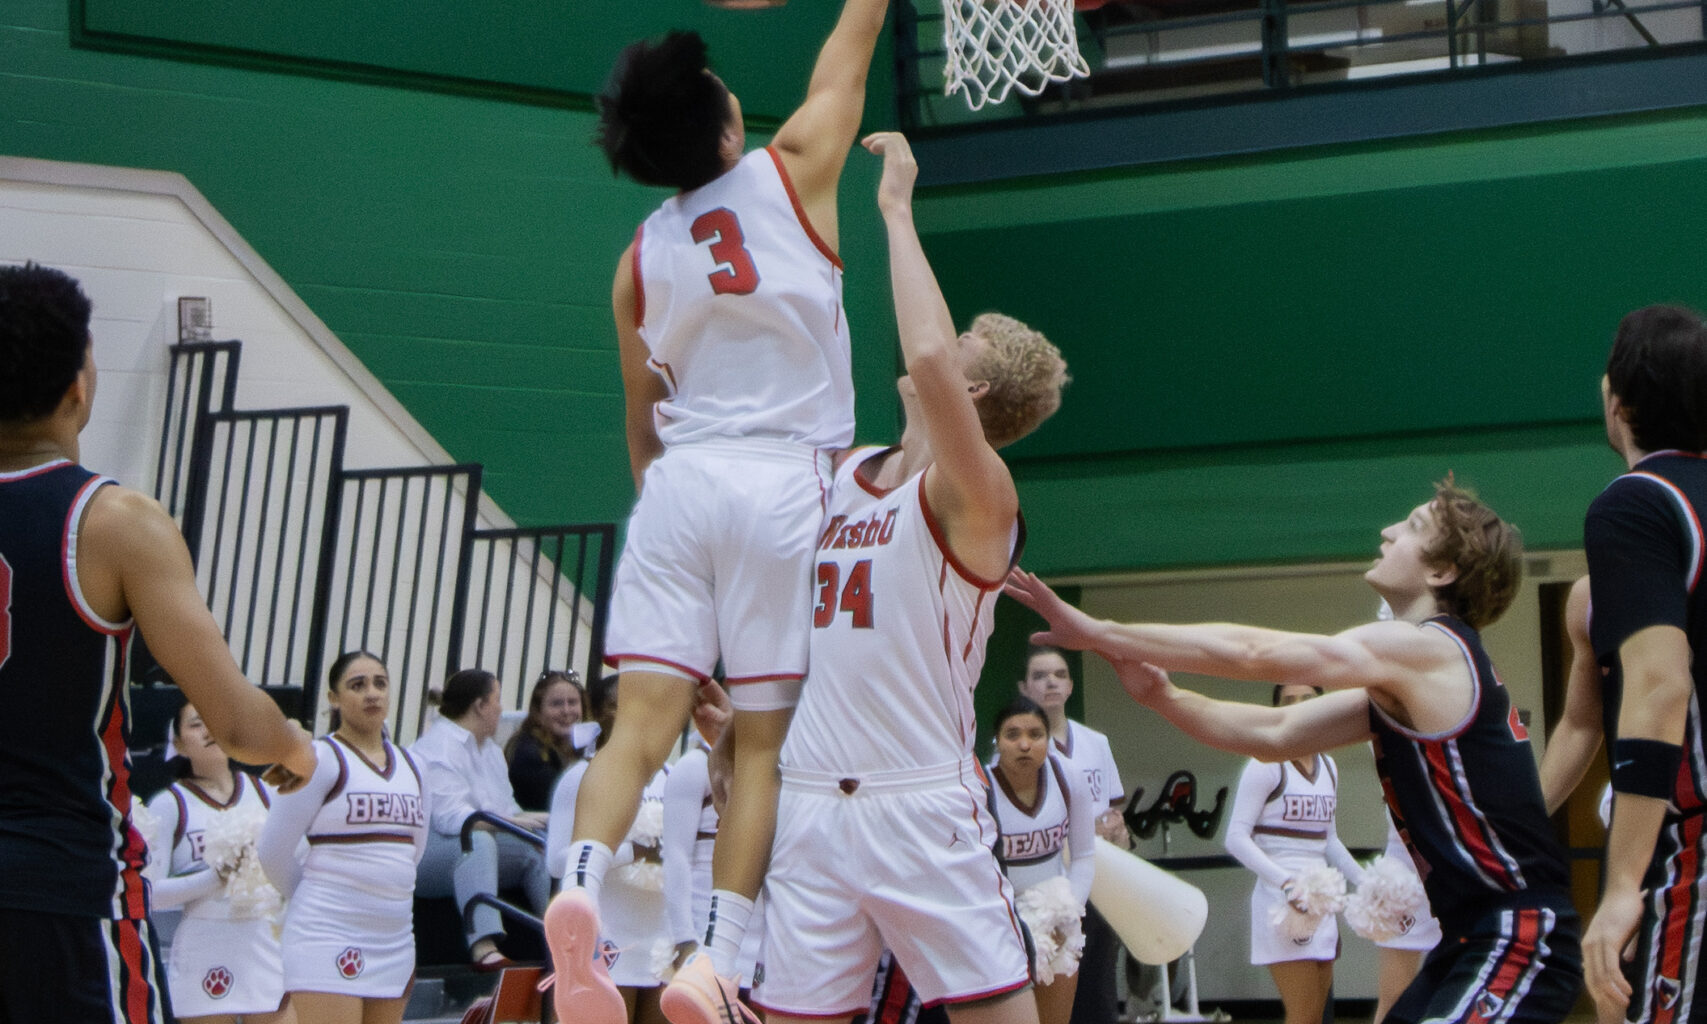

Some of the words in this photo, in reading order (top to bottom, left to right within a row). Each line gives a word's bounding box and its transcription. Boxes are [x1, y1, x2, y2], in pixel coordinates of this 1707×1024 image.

[689, 206, 761, 296] 3
[813, 559, 874, 629] 34
[1002, 817, 1069, 860] EAR
